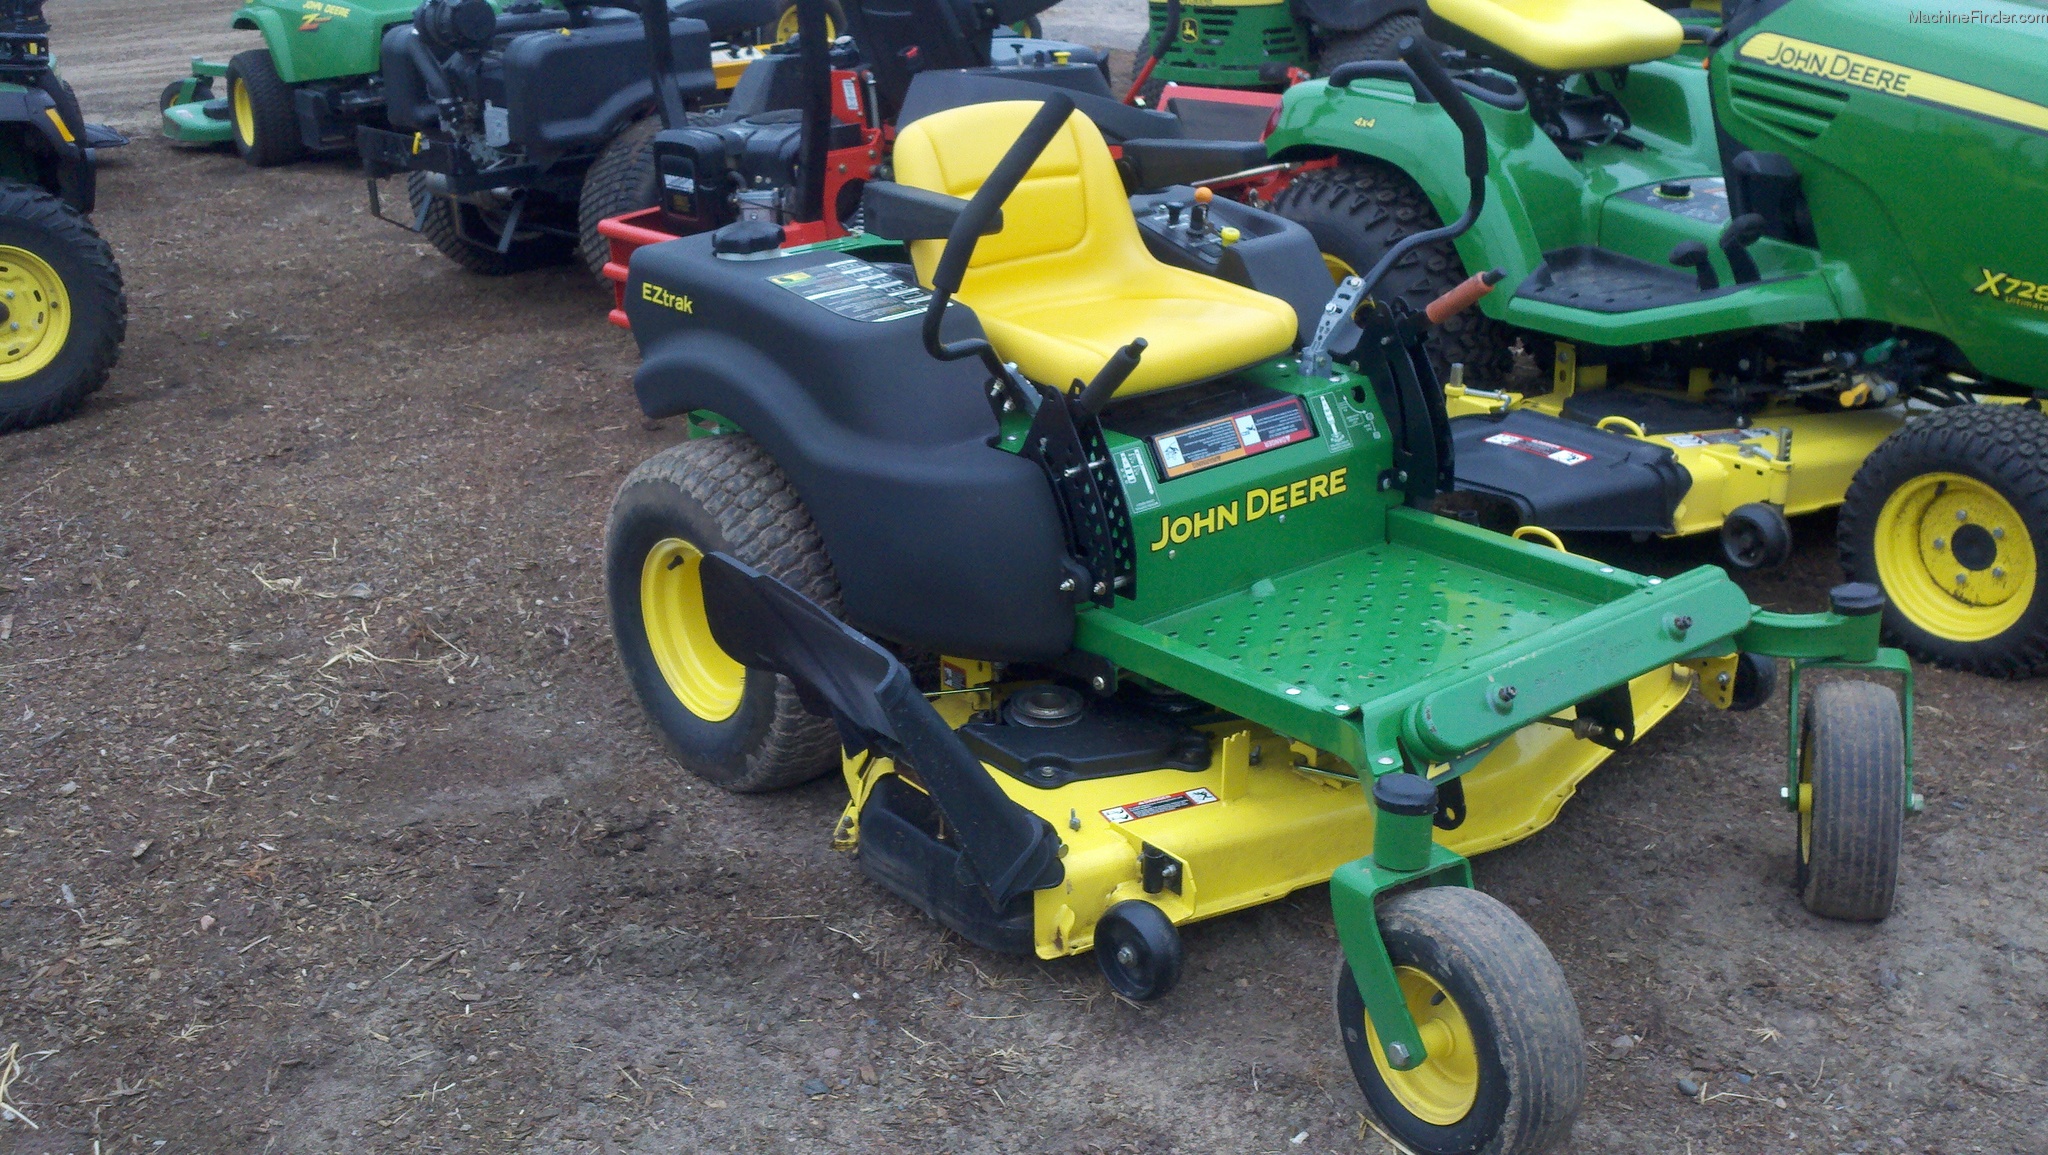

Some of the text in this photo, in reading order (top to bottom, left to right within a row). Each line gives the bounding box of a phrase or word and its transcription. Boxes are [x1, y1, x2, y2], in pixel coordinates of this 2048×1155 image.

[1767, 41, 1912, 92] JOHN DEERE
[642, 281, 694, 314] EZtrak
[1973, 268, 2048, 302] X728
[1151, 467, 1348, 551] JOHN DEERE
